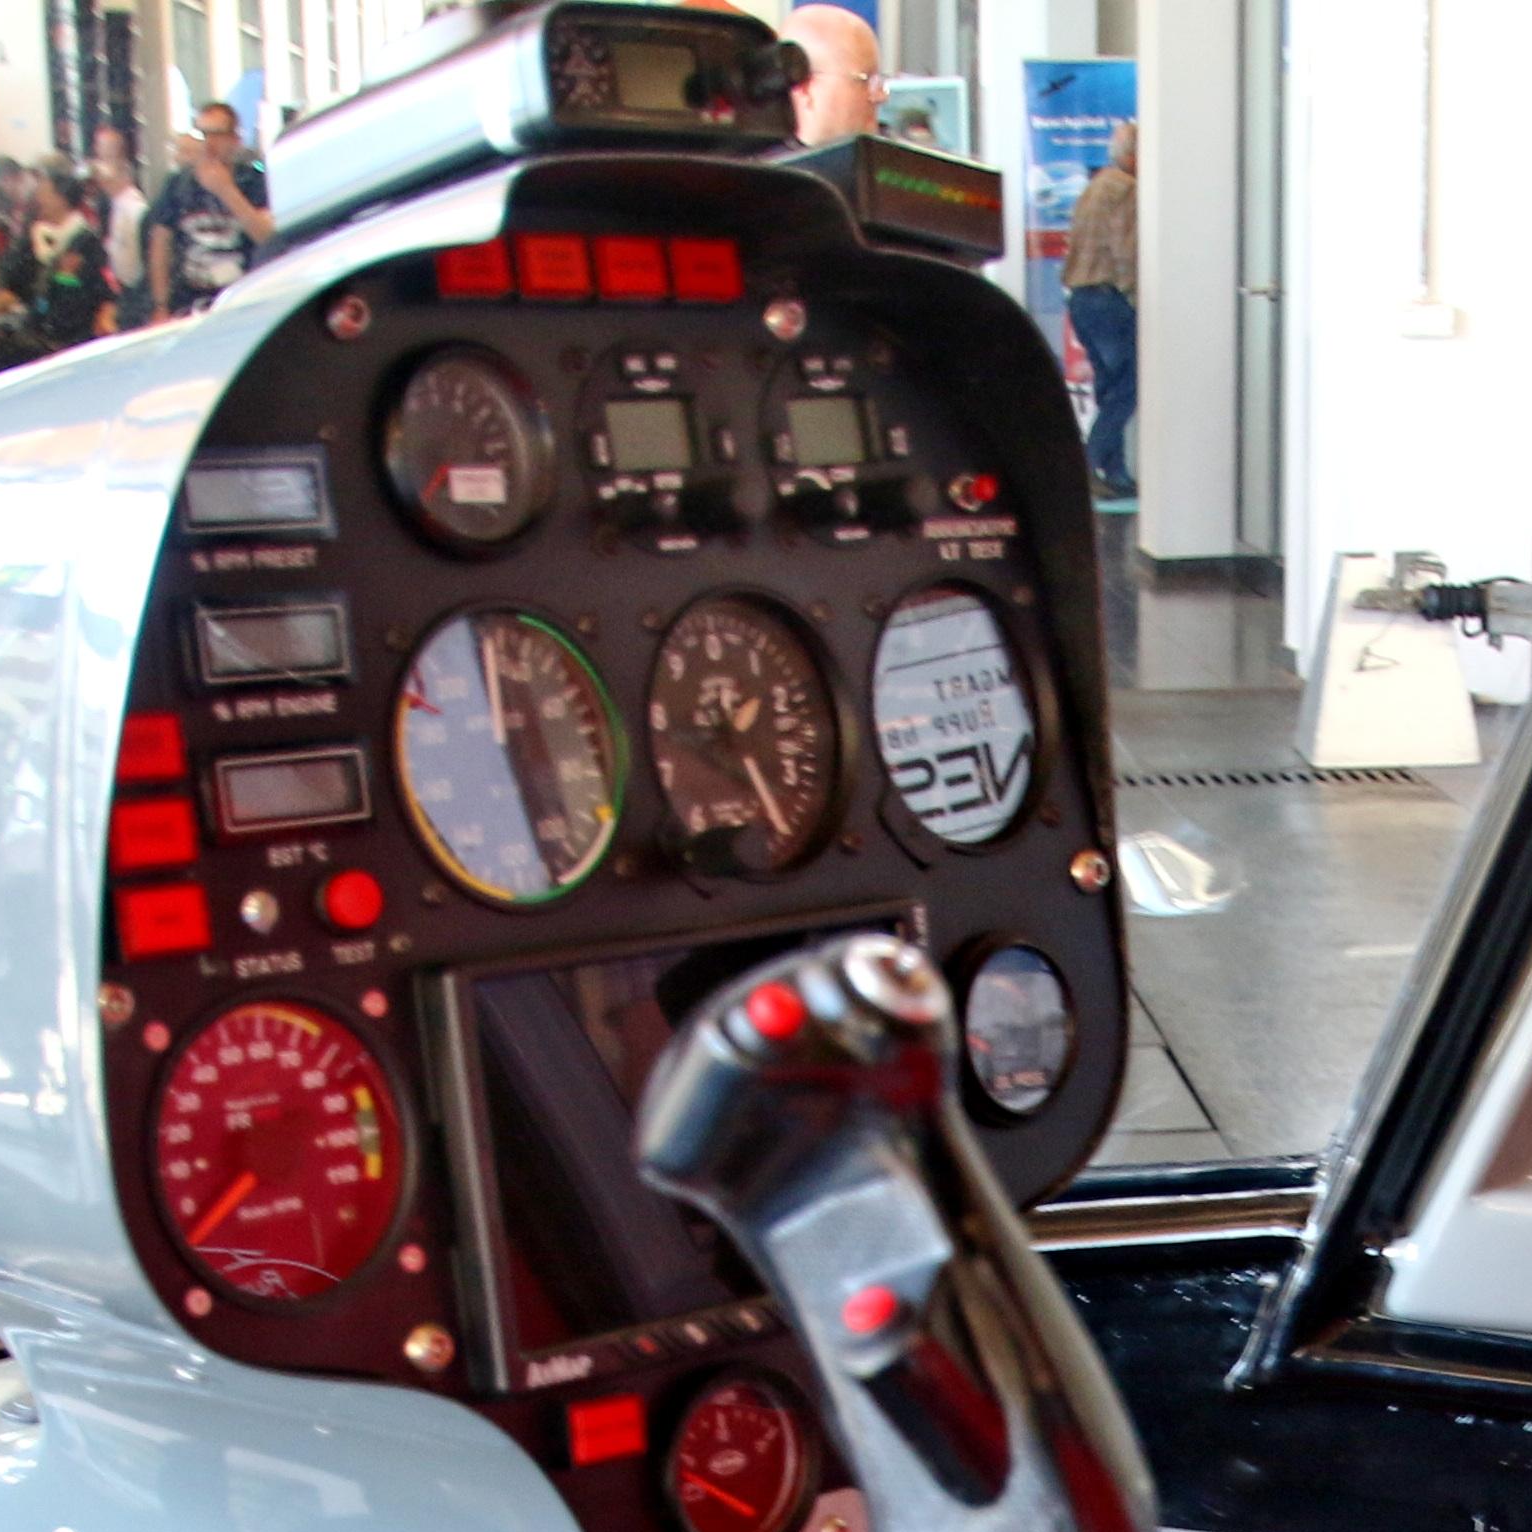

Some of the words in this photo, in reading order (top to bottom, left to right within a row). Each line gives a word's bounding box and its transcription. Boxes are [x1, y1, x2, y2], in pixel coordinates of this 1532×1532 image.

[213, 550, 250, 571] RPM
[252, 545, 317, 569] PRESET
[235, 699, 271, 719] RPM
[274, 692, 339, 718] ENGINE
[234, 951, 303, 979] STATUS
[331, 940, 376, 965] TEST
